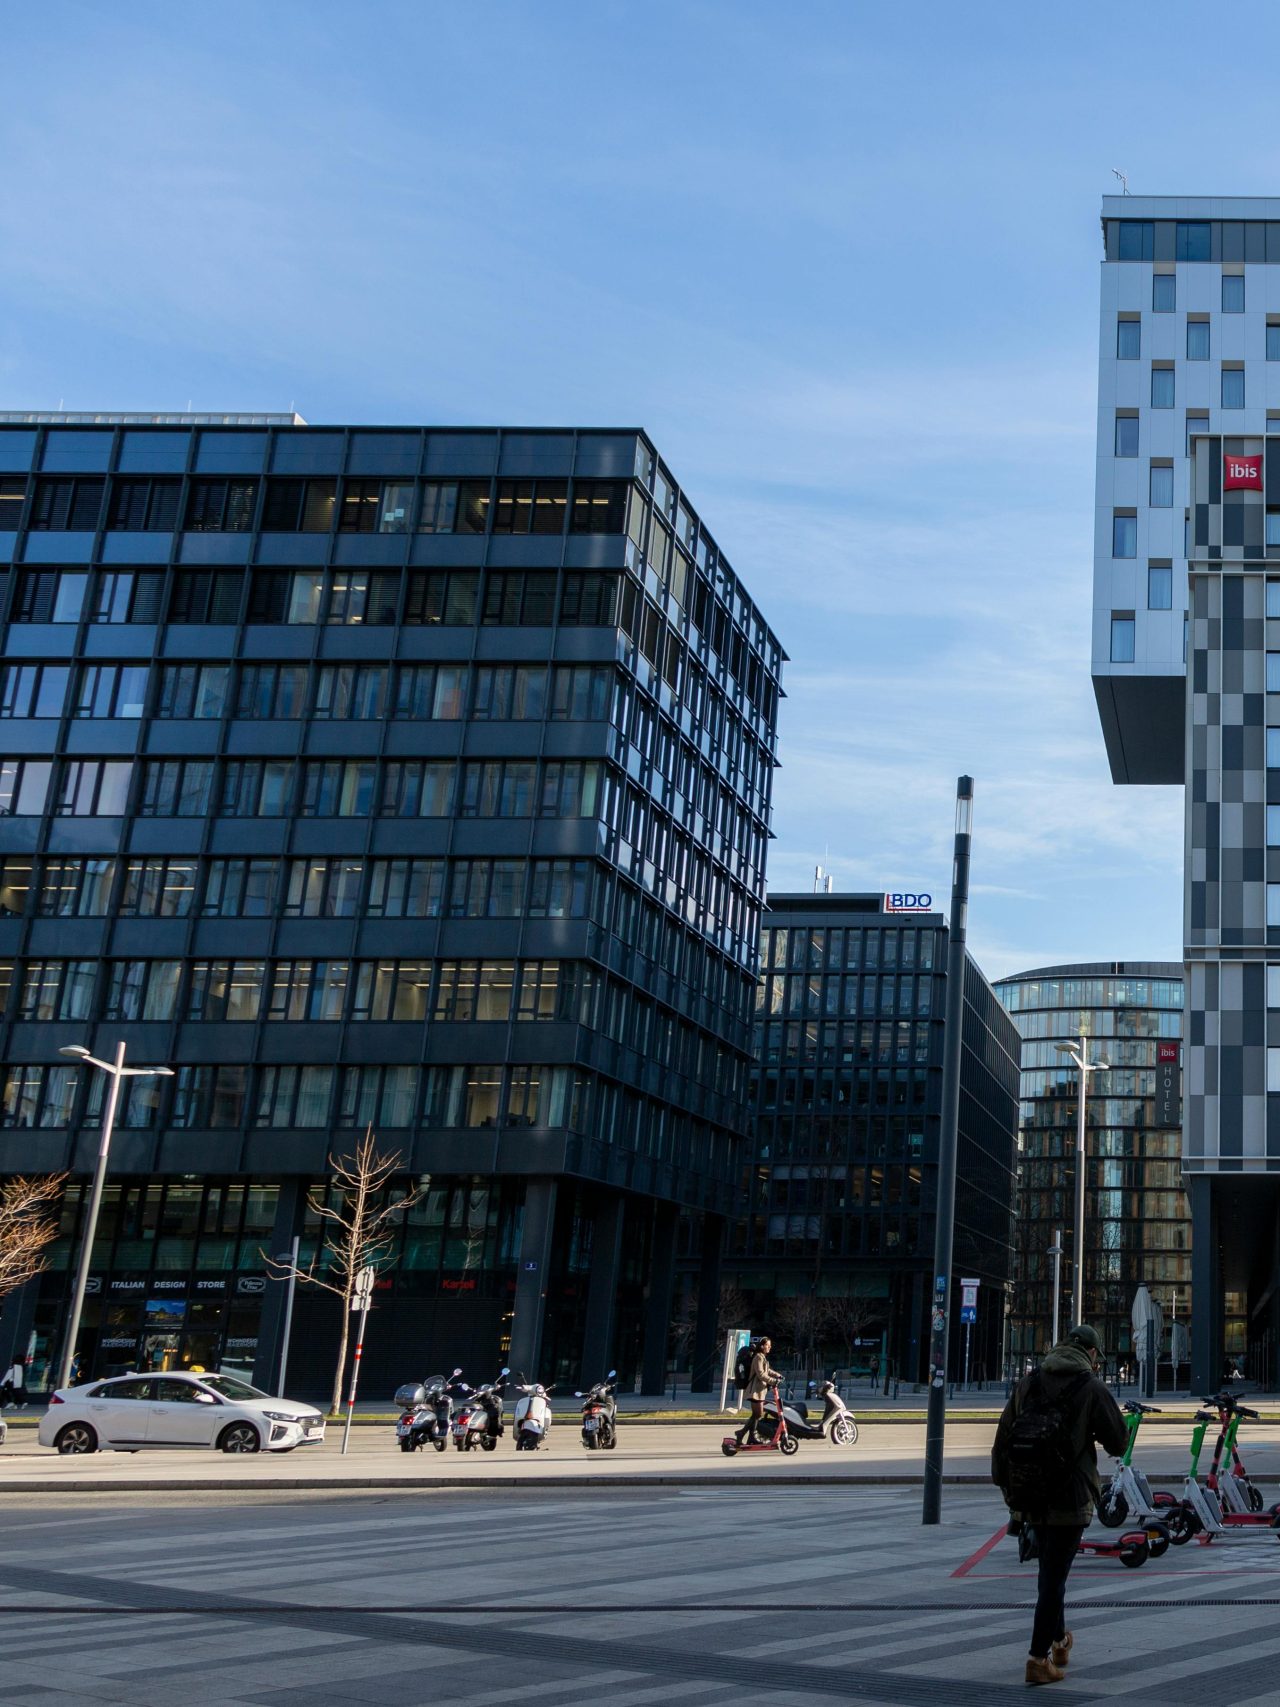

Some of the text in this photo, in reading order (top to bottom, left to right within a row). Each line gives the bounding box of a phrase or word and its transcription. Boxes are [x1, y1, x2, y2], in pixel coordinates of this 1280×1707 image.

[1230, 463, 1258, 478] ibis
[892, 893, 932, 907] BDO
[1161, 1048, 1175, 1057] ibis
[1163, 1067, 1171, 1122] HOTEL
[111, 1281, 226, 1289] ITALIAN DESIGN STORE
[442, 1279, 476, 1289] Kartell
